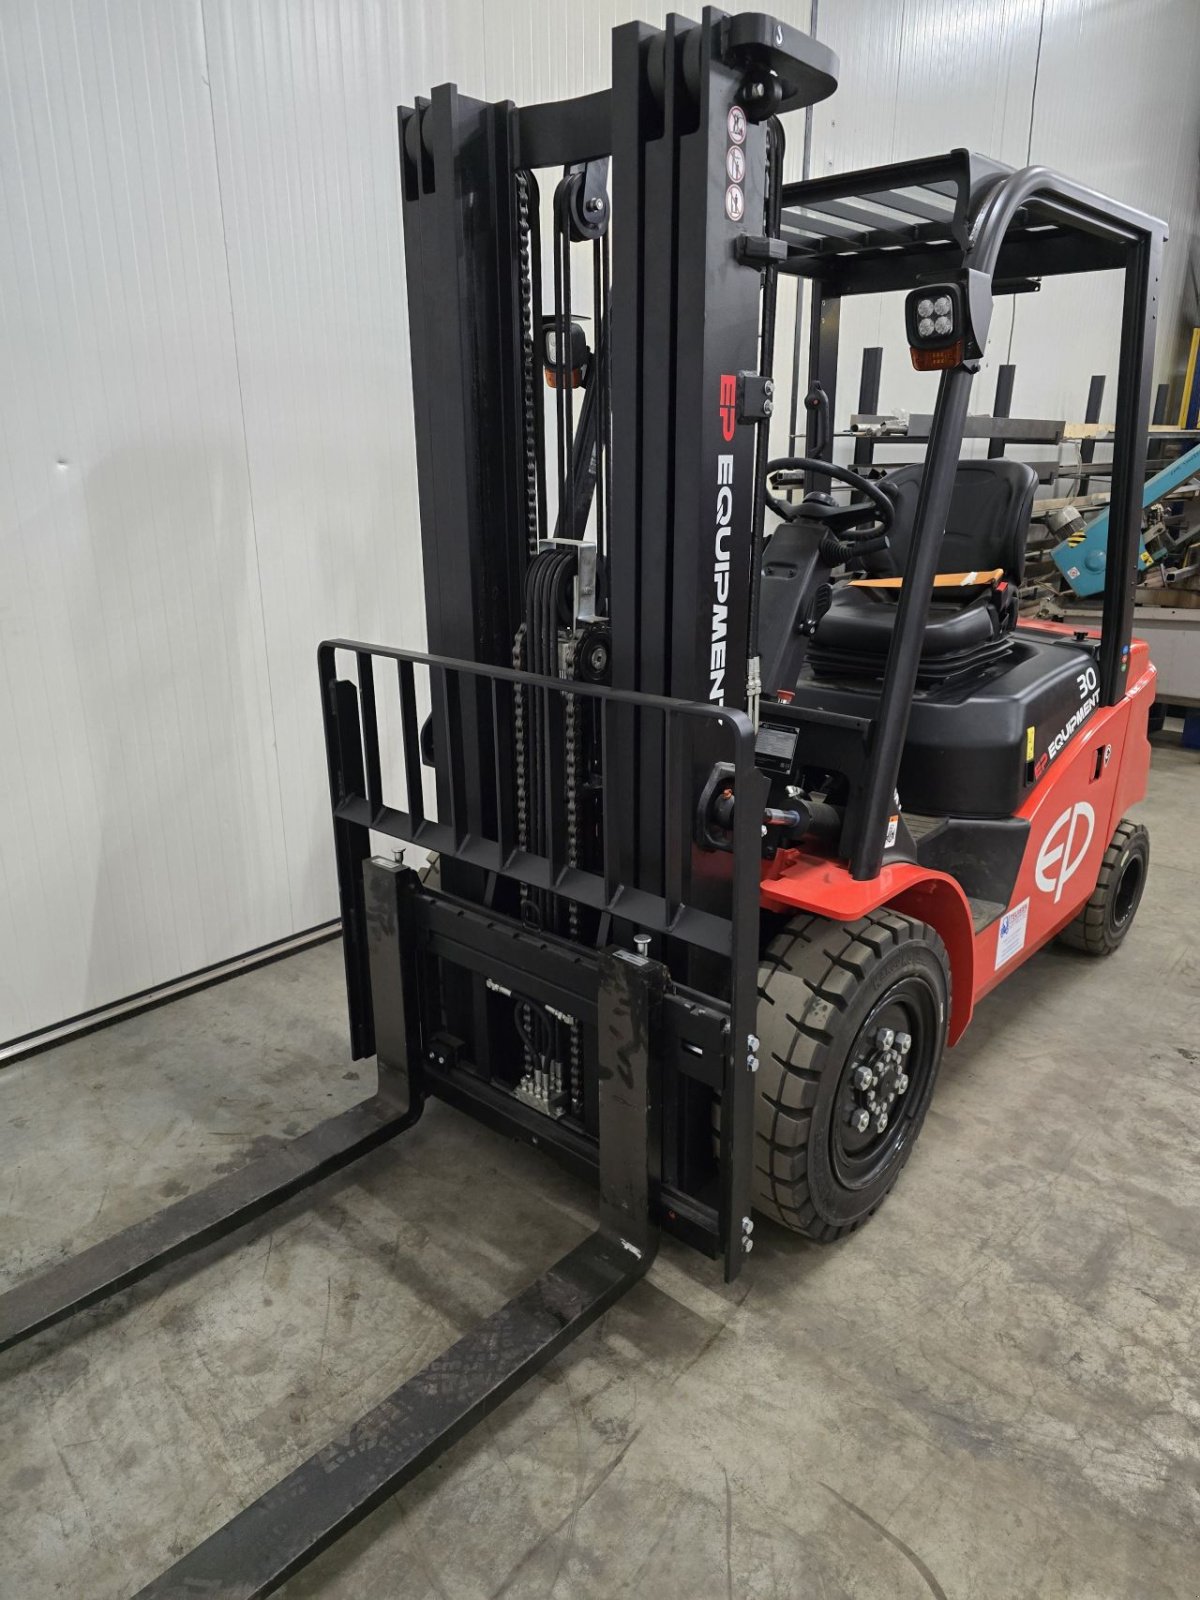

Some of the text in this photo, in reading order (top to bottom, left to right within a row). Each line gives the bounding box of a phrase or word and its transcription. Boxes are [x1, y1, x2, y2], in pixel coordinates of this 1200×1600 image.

[720, 375, 736, 442] EP
[1077, 667, 1097, 699] 30
[1034, 688, 1100, 779] EP EQUIPMENT
[1035, 801, 1095, 904] EP
